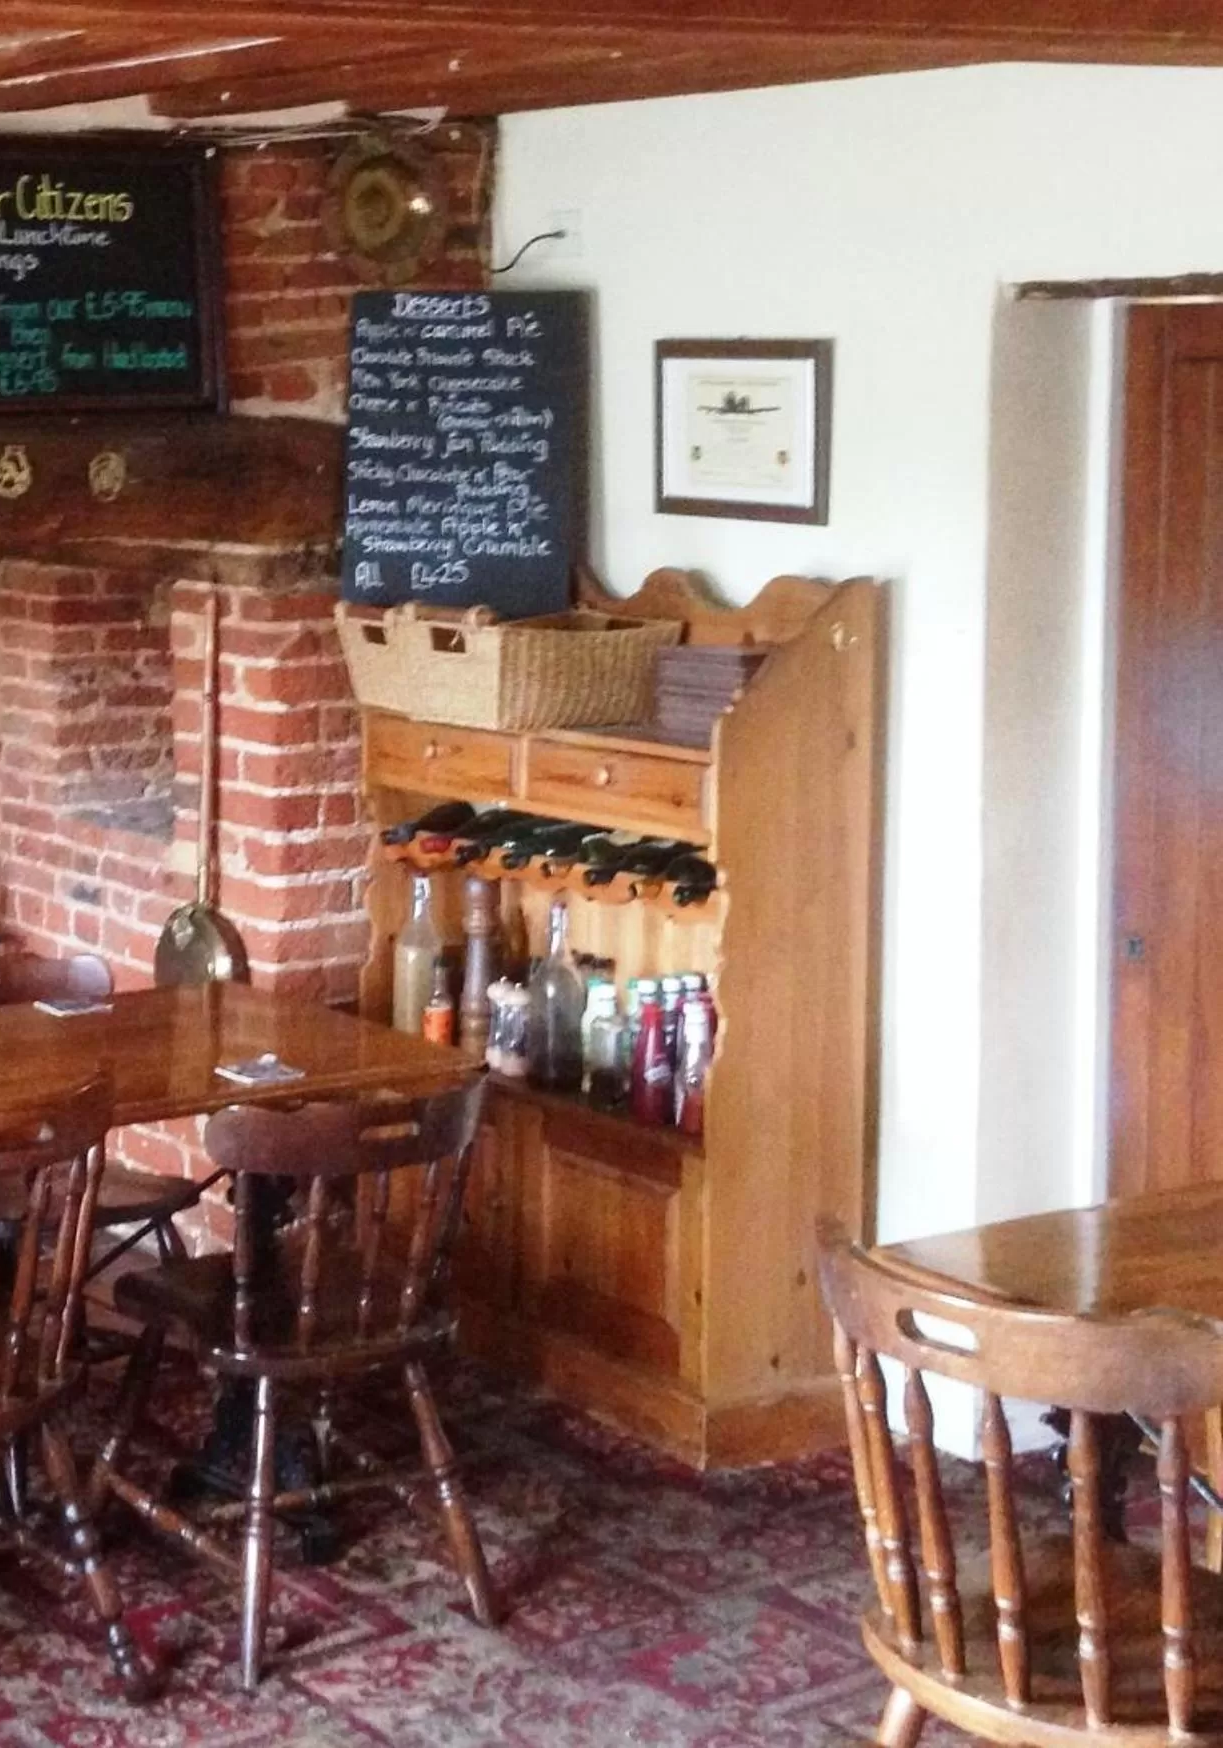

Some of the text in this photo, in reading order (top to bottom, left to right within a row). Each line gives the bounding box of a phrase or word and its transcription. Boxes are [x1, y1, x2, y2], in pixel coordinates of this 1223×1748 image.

[16, 173, 135, 222] Citizens
[348, 494, 400, 515] Lemon
[462, 534, 553, 557] Crumble
